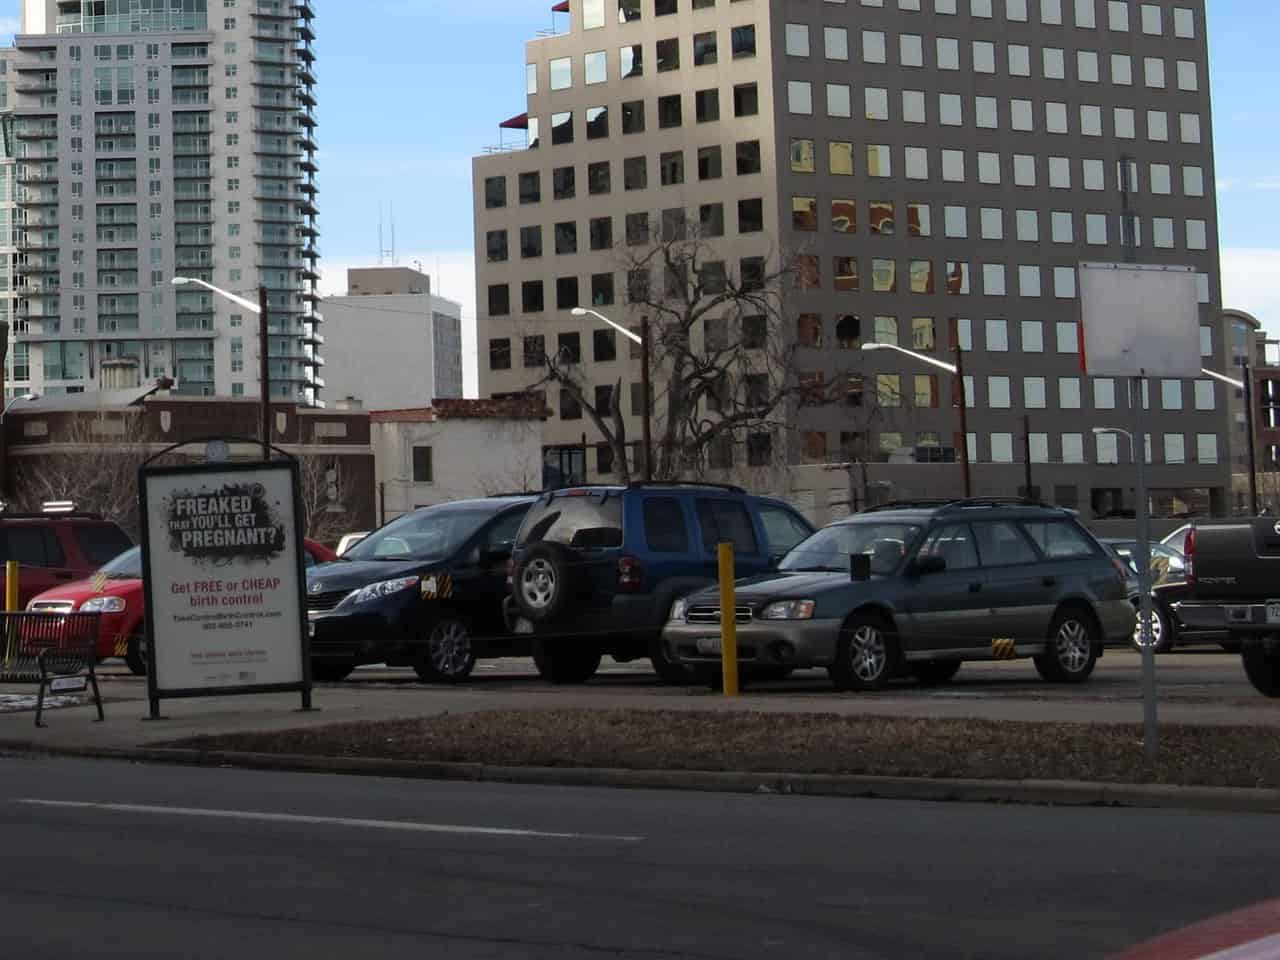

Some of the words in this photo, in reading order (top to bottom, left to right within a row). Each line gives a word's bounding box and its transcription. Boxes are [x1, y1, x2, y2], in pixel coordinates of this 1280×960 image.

[176, 496, 252, 516] FREAKED
[191, 514, 232, 529] YOU'LL
[234, 513, 257, 527] GET
[181, 527, 277, 548] PREGNANT?
[171, 581, 191, 594] Get
[194, 580, 223, 593] FREE
[226, 582, 240, 592] or
[241, 577, 281, 591] CHEAP
[190, 594, 218, 607] birth
[221, 592, 264, 606] control
